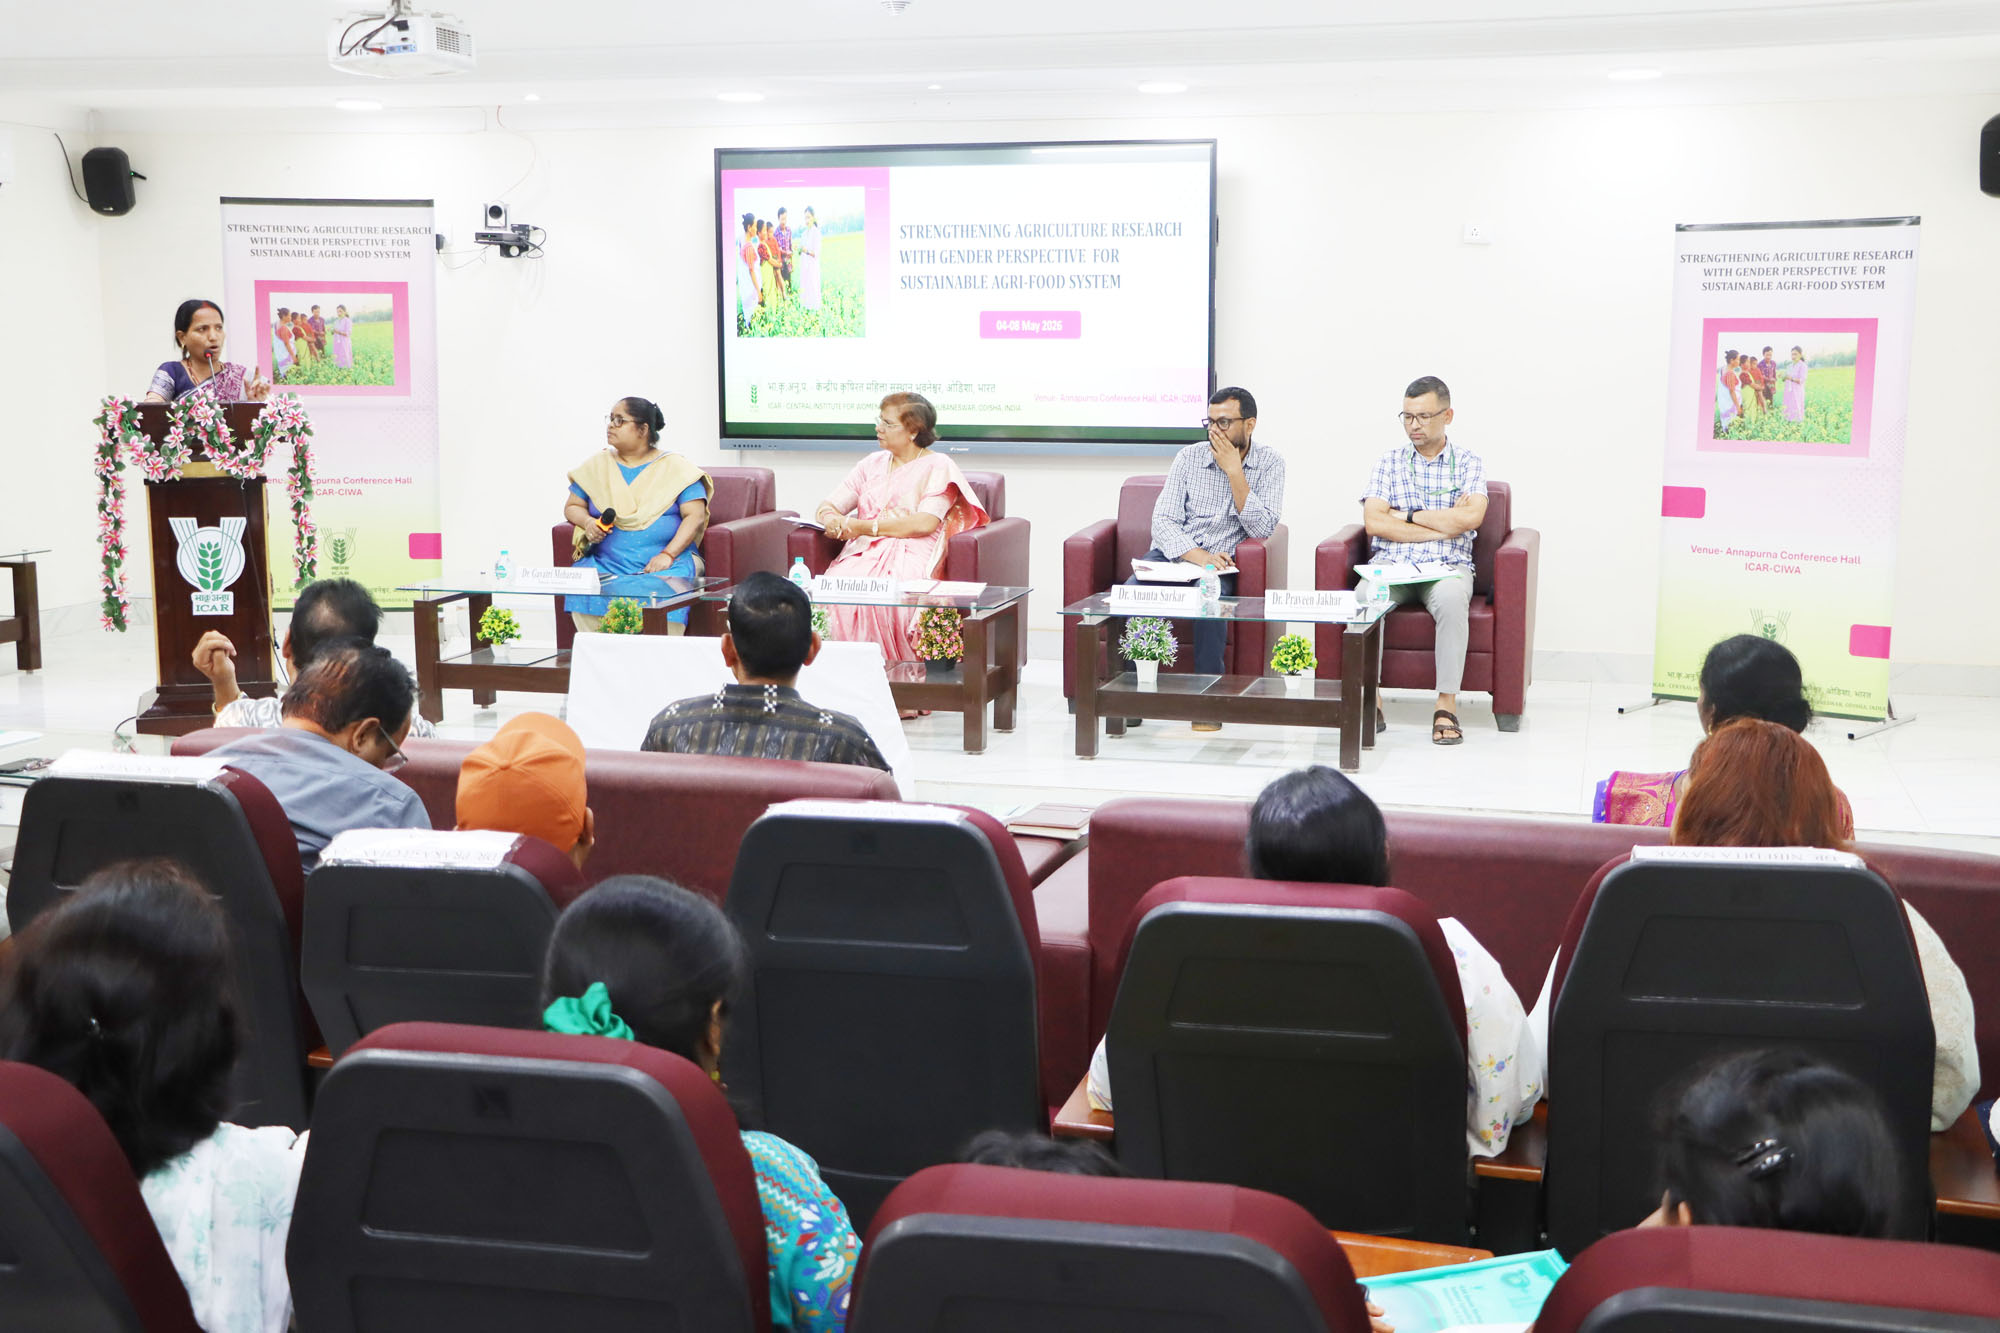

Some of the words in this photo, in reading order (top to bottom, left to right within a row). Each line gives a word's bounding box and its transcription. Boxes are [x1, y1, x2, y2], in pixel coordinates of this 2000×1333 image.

[227, 224, 310, 234] STRENGTHENING
[312, 225, 380, 234] AGRICULTURE
[381, 226, 432, 235] RESEARCH
[900, 224, 1011, 239] STRENGTHENING
[1014, 223, 1108, 238] AGRICULTURE
[1112, 222, 1182, 237] RESEARCH
[250, 236, 277, 245] WITH
[280, 237, 320, 246] GENDER
[322, 238, 385, 246] PERSPECTIVE
[391, 239, 410, 247] FOR
[250, 249, 315, 258] SUSTAINABLE
[318, 250, 372, 258] AGRI-FOOD
[374, 250, 411, 259] SYSTEM
[900, 250, 936, 264] WITH
[940, 249, 994, 264] GENDER
[997, 248, 1086, 264] PERSPECTIVE
[1093, 248, 1120, 263] FOR
[1680, 253, 1770, 263] STRENGTHENING
[1772, 252, 1850, 262] AGRICULTURE
[1852, 250, 1914, 260] RESEARCH
[1704, 267, 1732, 277] WITH
[1736, 267, 1780, 276] GENDER
[1782, 266, 1857, 276] PERSPECTIVE
[1863, 266, 1886, 275] FOR
[900, 275, 988, 290] SUSTAINABLE
[992, 274, 1066, 290] AGRI-FOOD
[1068, 274, 1121, 289] SYSTEM
[1701, 281, 1774, 291] SUSTAINABLE
[1776, 280, 1838, 290] AGRI-FOOD
[1840, 280, 1886, 290] SYSTEM
[1022, 320, 1040, 334] May
[1100, 394, 1140, 402] Conference
[1691, 544, 1723, 555] Venue-
[1726, 547, 1778, 560] Annapurna
[1780, 551, 1838, 563] Conference
[1840, 555, 1861, 565] Hall
[1745, 562, 1801, 575] ICAR-CIWA
[820, 579, 833, 591] Dr.
[837, 579, 867, 591] Mridula
[870, 580, 889, 592] Devi
[1118, 588, 1130, 600] Dr.
[1131, 589, 1157, 601] Ananta
[1160, 590, 1186, 602] Sarkar
[1272, 592, 1283, 605] Dr.
[1285, 592, 1314, 606] Praveen
[1316, 593, 1342, 606] Jakhar
[196, 604, 229, 612] ICAR
